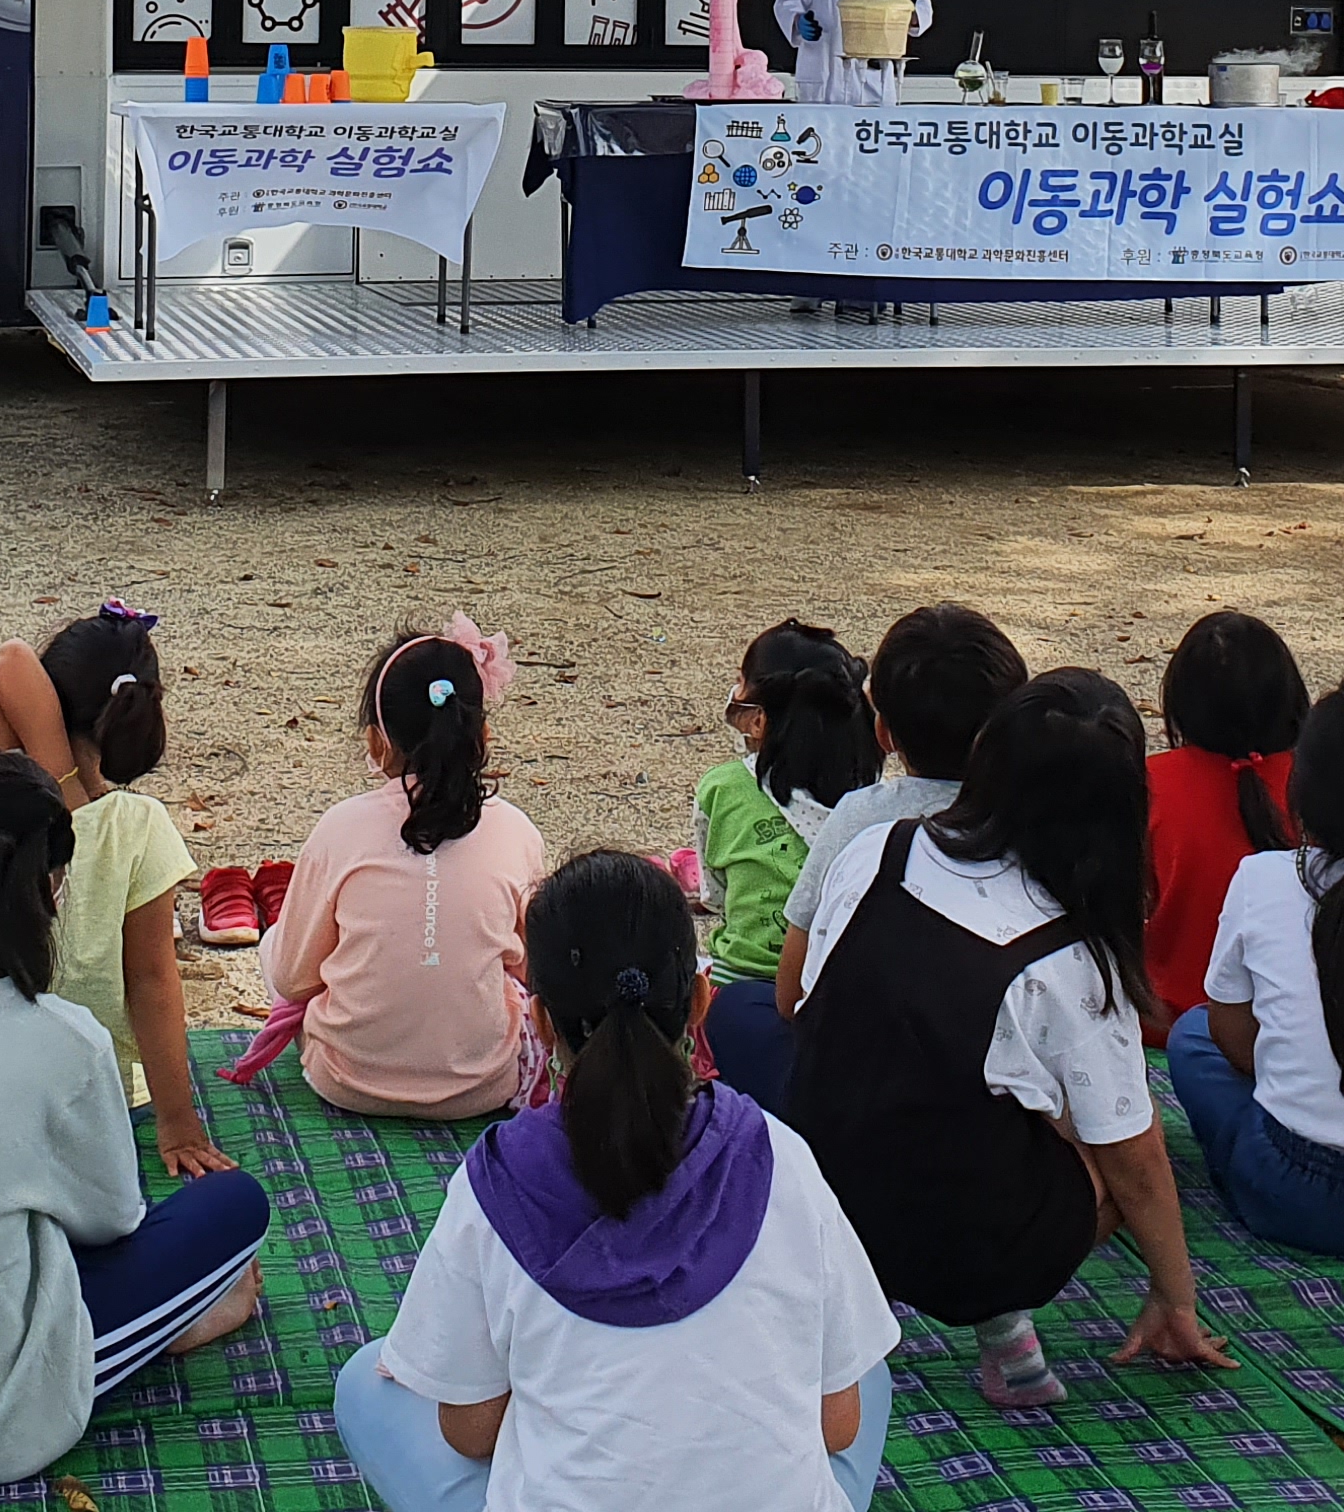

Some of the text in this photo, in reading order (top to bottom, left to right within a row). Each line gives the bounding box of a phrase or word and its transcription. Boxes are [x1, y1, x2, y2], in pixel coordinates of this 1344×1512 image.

[175, 124, 459, 141] 한국교통대학교 이동과학교실
[854, 119, 1245, 157] 한국교통대학교 이동과학교실
[167, 145, 454, 179] 이동과학 실험쇼
[977, 167, 1191, 237] 이동과학
[827, 243, 858, 261] 주관
[901, 247, 979, 261] 한국교통대학교
[981, 249, 1070, 263] 과학문화진흥센터
[1120, 248, 1151, 266] 후원
[425, 851, 436, 877] ew
[424, 880, 439, 948] balance
